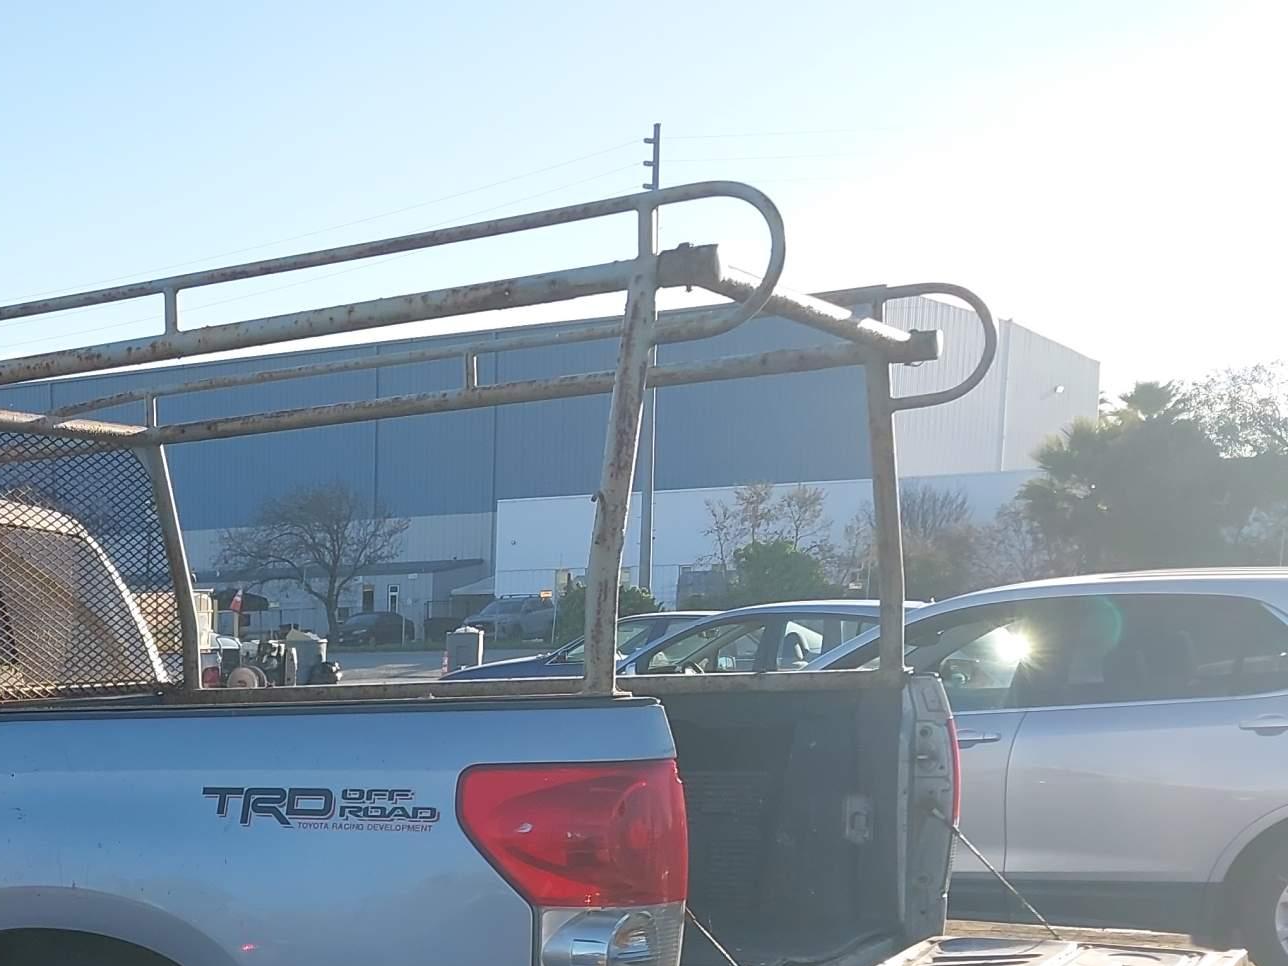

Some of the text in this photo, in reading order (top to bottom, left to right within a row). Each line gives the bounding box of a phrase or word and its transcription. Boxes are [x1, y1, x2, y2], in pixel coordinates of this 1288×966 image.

[341, 789, 414, 805] OFF
[202, 787, 335, 829] TRD
[338, 805, 440, 822] ROAD
[297, 822, 433, 833] TOYOTA RACING DEVELOPMENT
